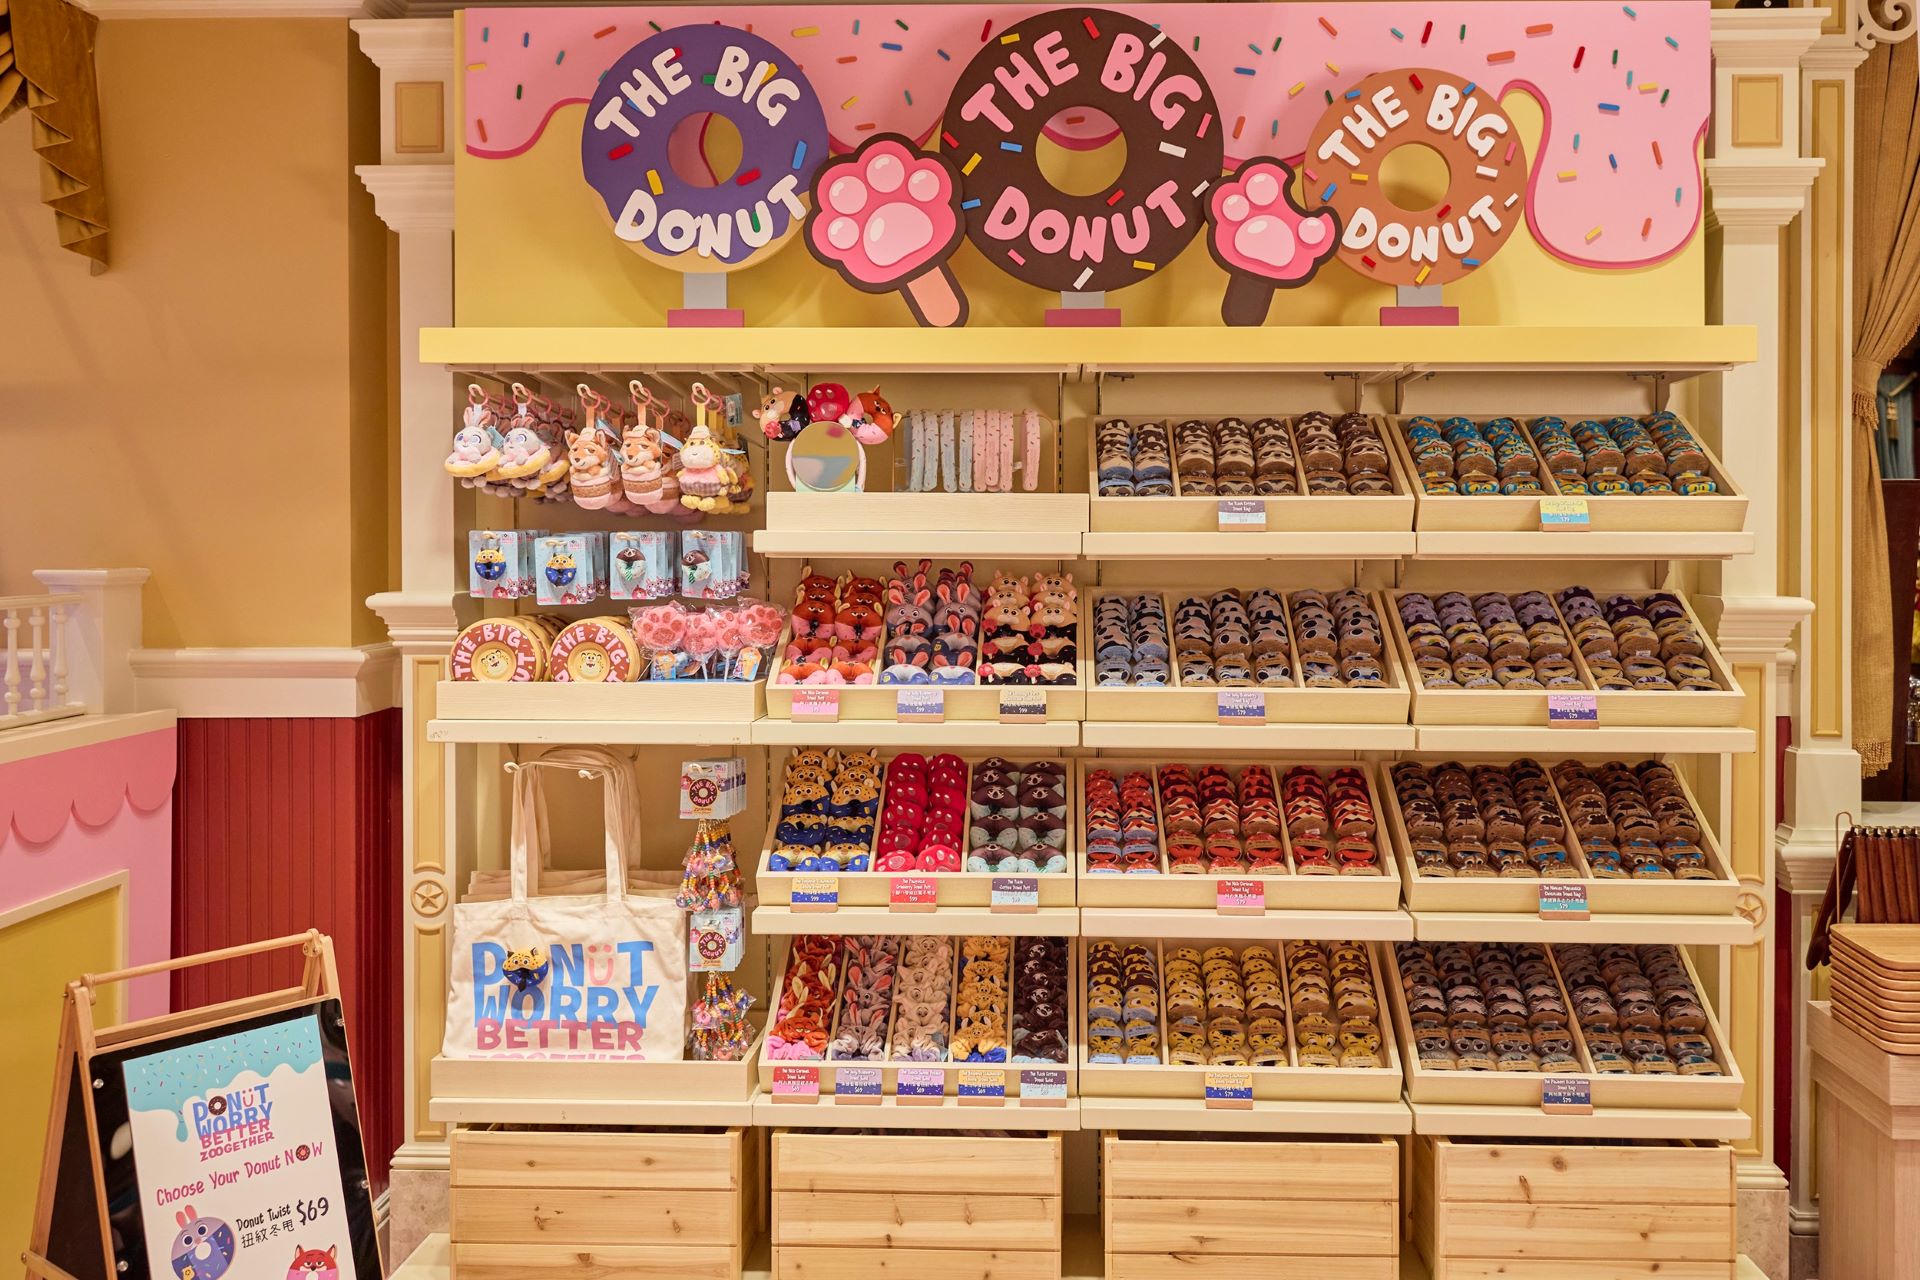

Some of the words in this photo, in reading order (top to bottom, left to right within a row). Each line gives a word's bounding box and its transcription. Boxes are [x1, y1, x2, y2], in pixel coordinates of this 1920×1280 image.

[594, 48, 692, 137] THE
[714, 46, 800, 127] BIG
[961, 30, 1079, 133] THE
[1100, 33, 1202, 131] BIG
[1318, 86, 1409, 167] THE
[1426, 84, 1508, 157] BIG
[614, 174, 807, 259] DONUT
[984, 180, 1186, 263] DONUT
[1341, 195, 1502, 263] DONUT
[455, 636, 477, 678] THE
[482, 624, 521, 648] BIG
[553, 626, 586, 658] THE
[595, 624, 627, 666] BIG
[474, 985, 660, 1030] WORRY
[476, 1018, 644, 1051] BETTER
[195, 1102, 273, 1140] WORRY
[200, 1119, 270, 1149] BETTER
[200, 1132, 275, 1162] ZOOGETHER
[157, 1179, 205, 1206] Choose
[209, 1169, 240, 1190] Your
[244, 1153, 281, 1179] Donut
[236, 1212, 264, 1232] Donut
[267, 1203, 291, 1222] Twist
[296, 1196, 329, 1226] $69
[241, 1221, 295, 1249] 扭紋冬甩
